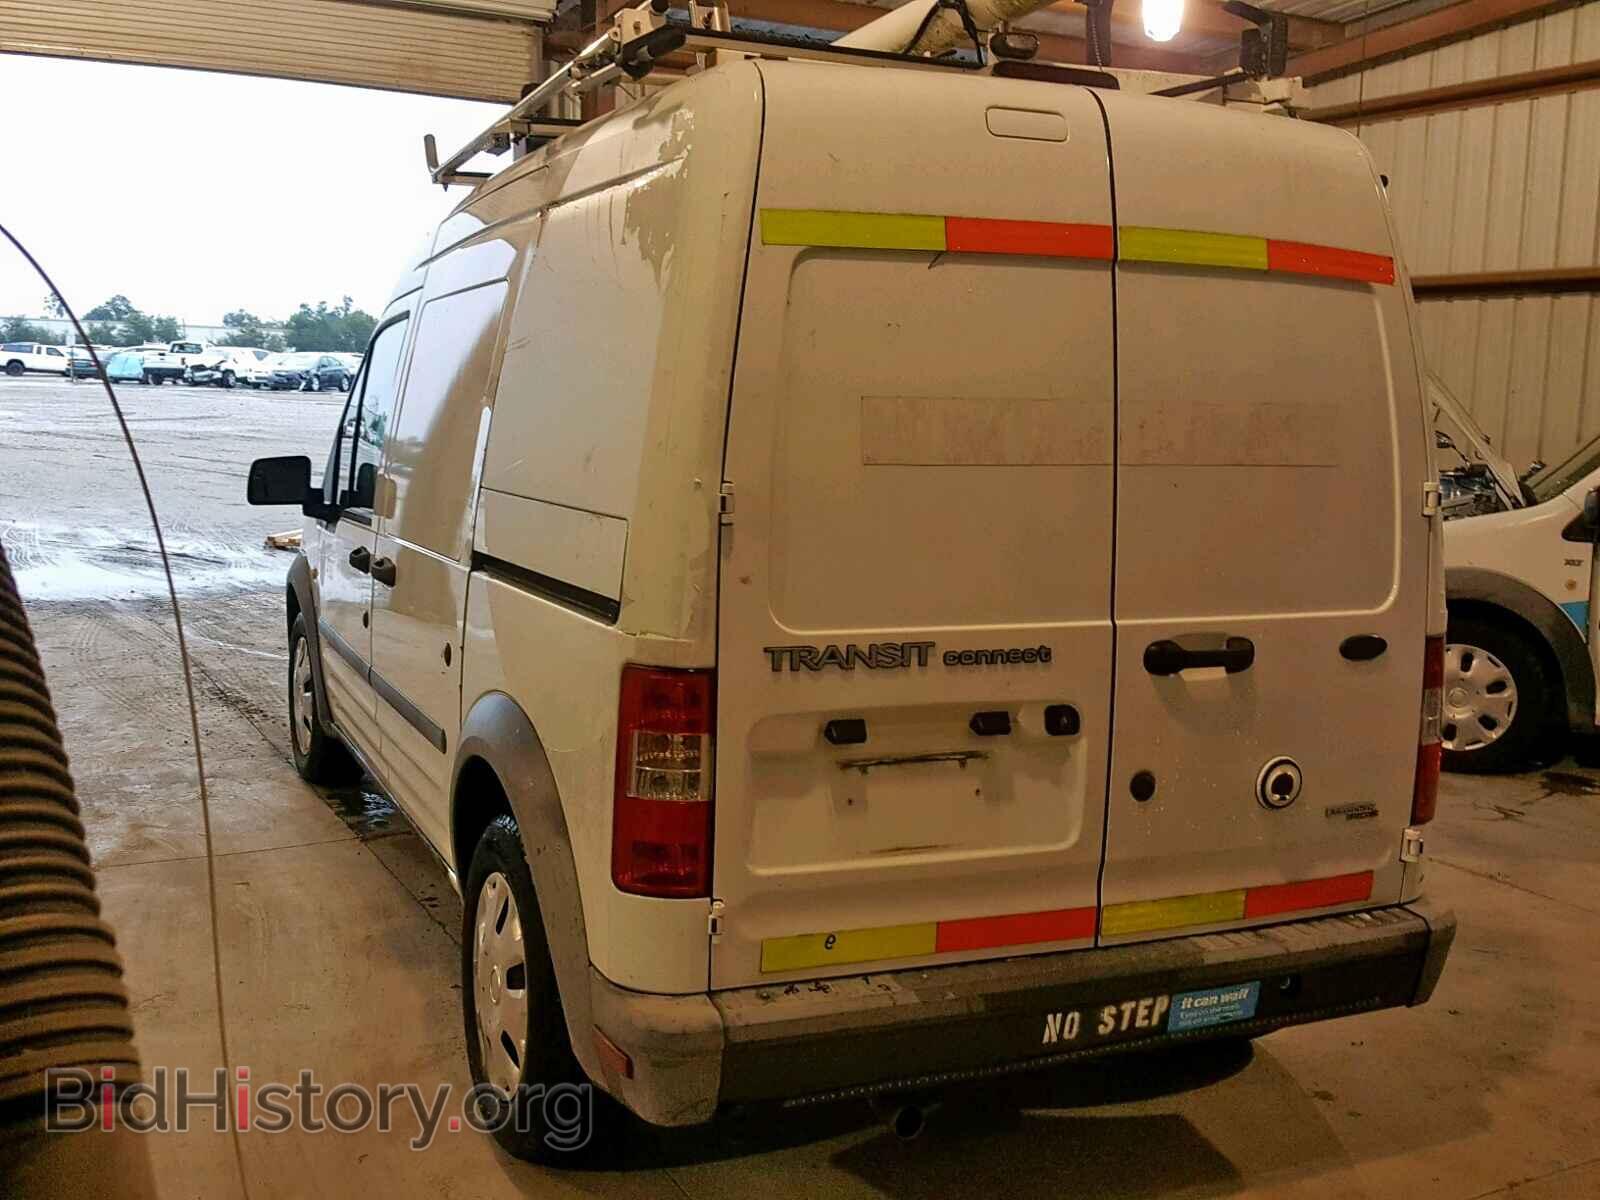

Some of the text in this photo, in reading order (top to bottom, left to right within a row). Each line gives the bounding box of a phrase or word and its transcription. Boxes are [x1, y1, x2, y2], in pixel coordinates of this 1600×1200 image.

[764, 641, 1052, 672] TRANSIT connect
[1042, 1011, 1080, 1044] NO
[1098, 995, 1170, 1035] STEP
